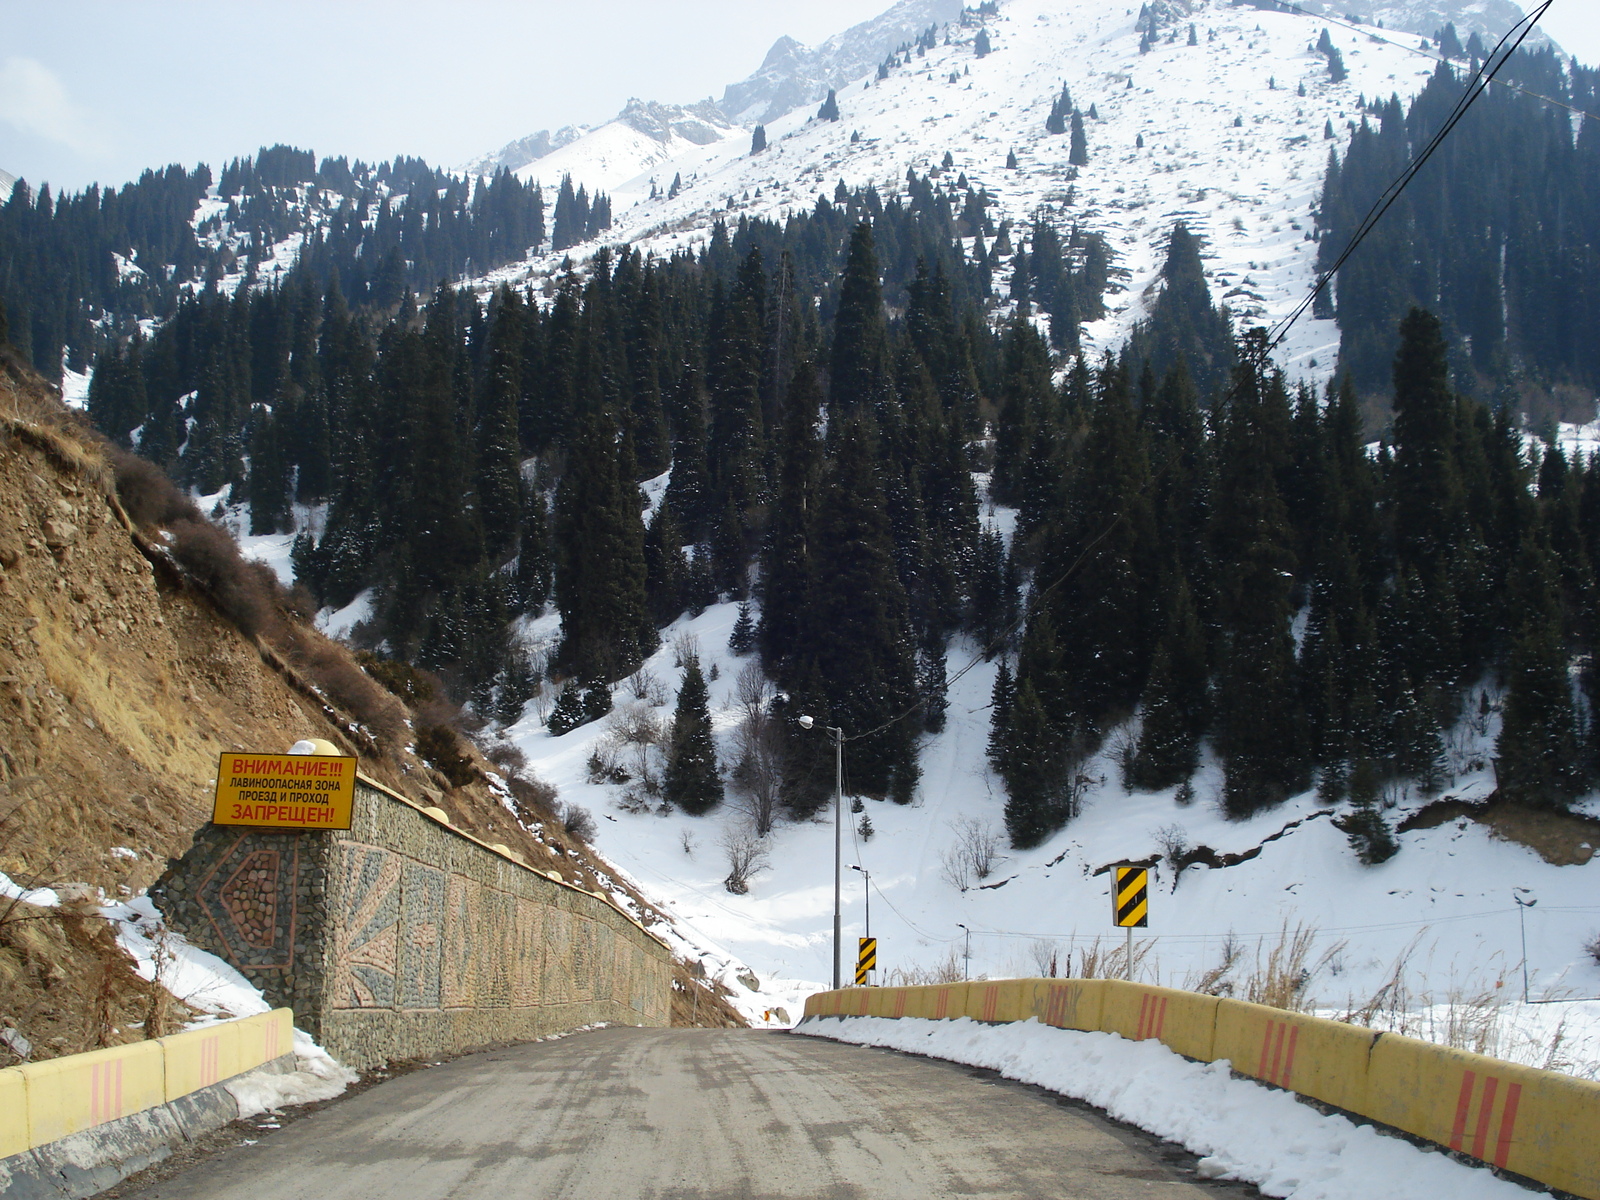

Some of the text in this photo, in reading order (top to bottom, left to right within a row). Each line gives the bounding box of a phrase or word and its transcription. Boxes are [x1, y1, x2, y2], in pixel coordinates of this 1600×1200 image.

[232, 759, 343, 777] ВНИМАНИЕ!!!
[230, 777, 341, 791] ЛАВИНООПАСНАЯ ЗОНА
[239, 791, 329, 805] ПРОЕЗД И ПРОХОД
[231, 804, 335, 824] ЗАПРЕЩЕН!
